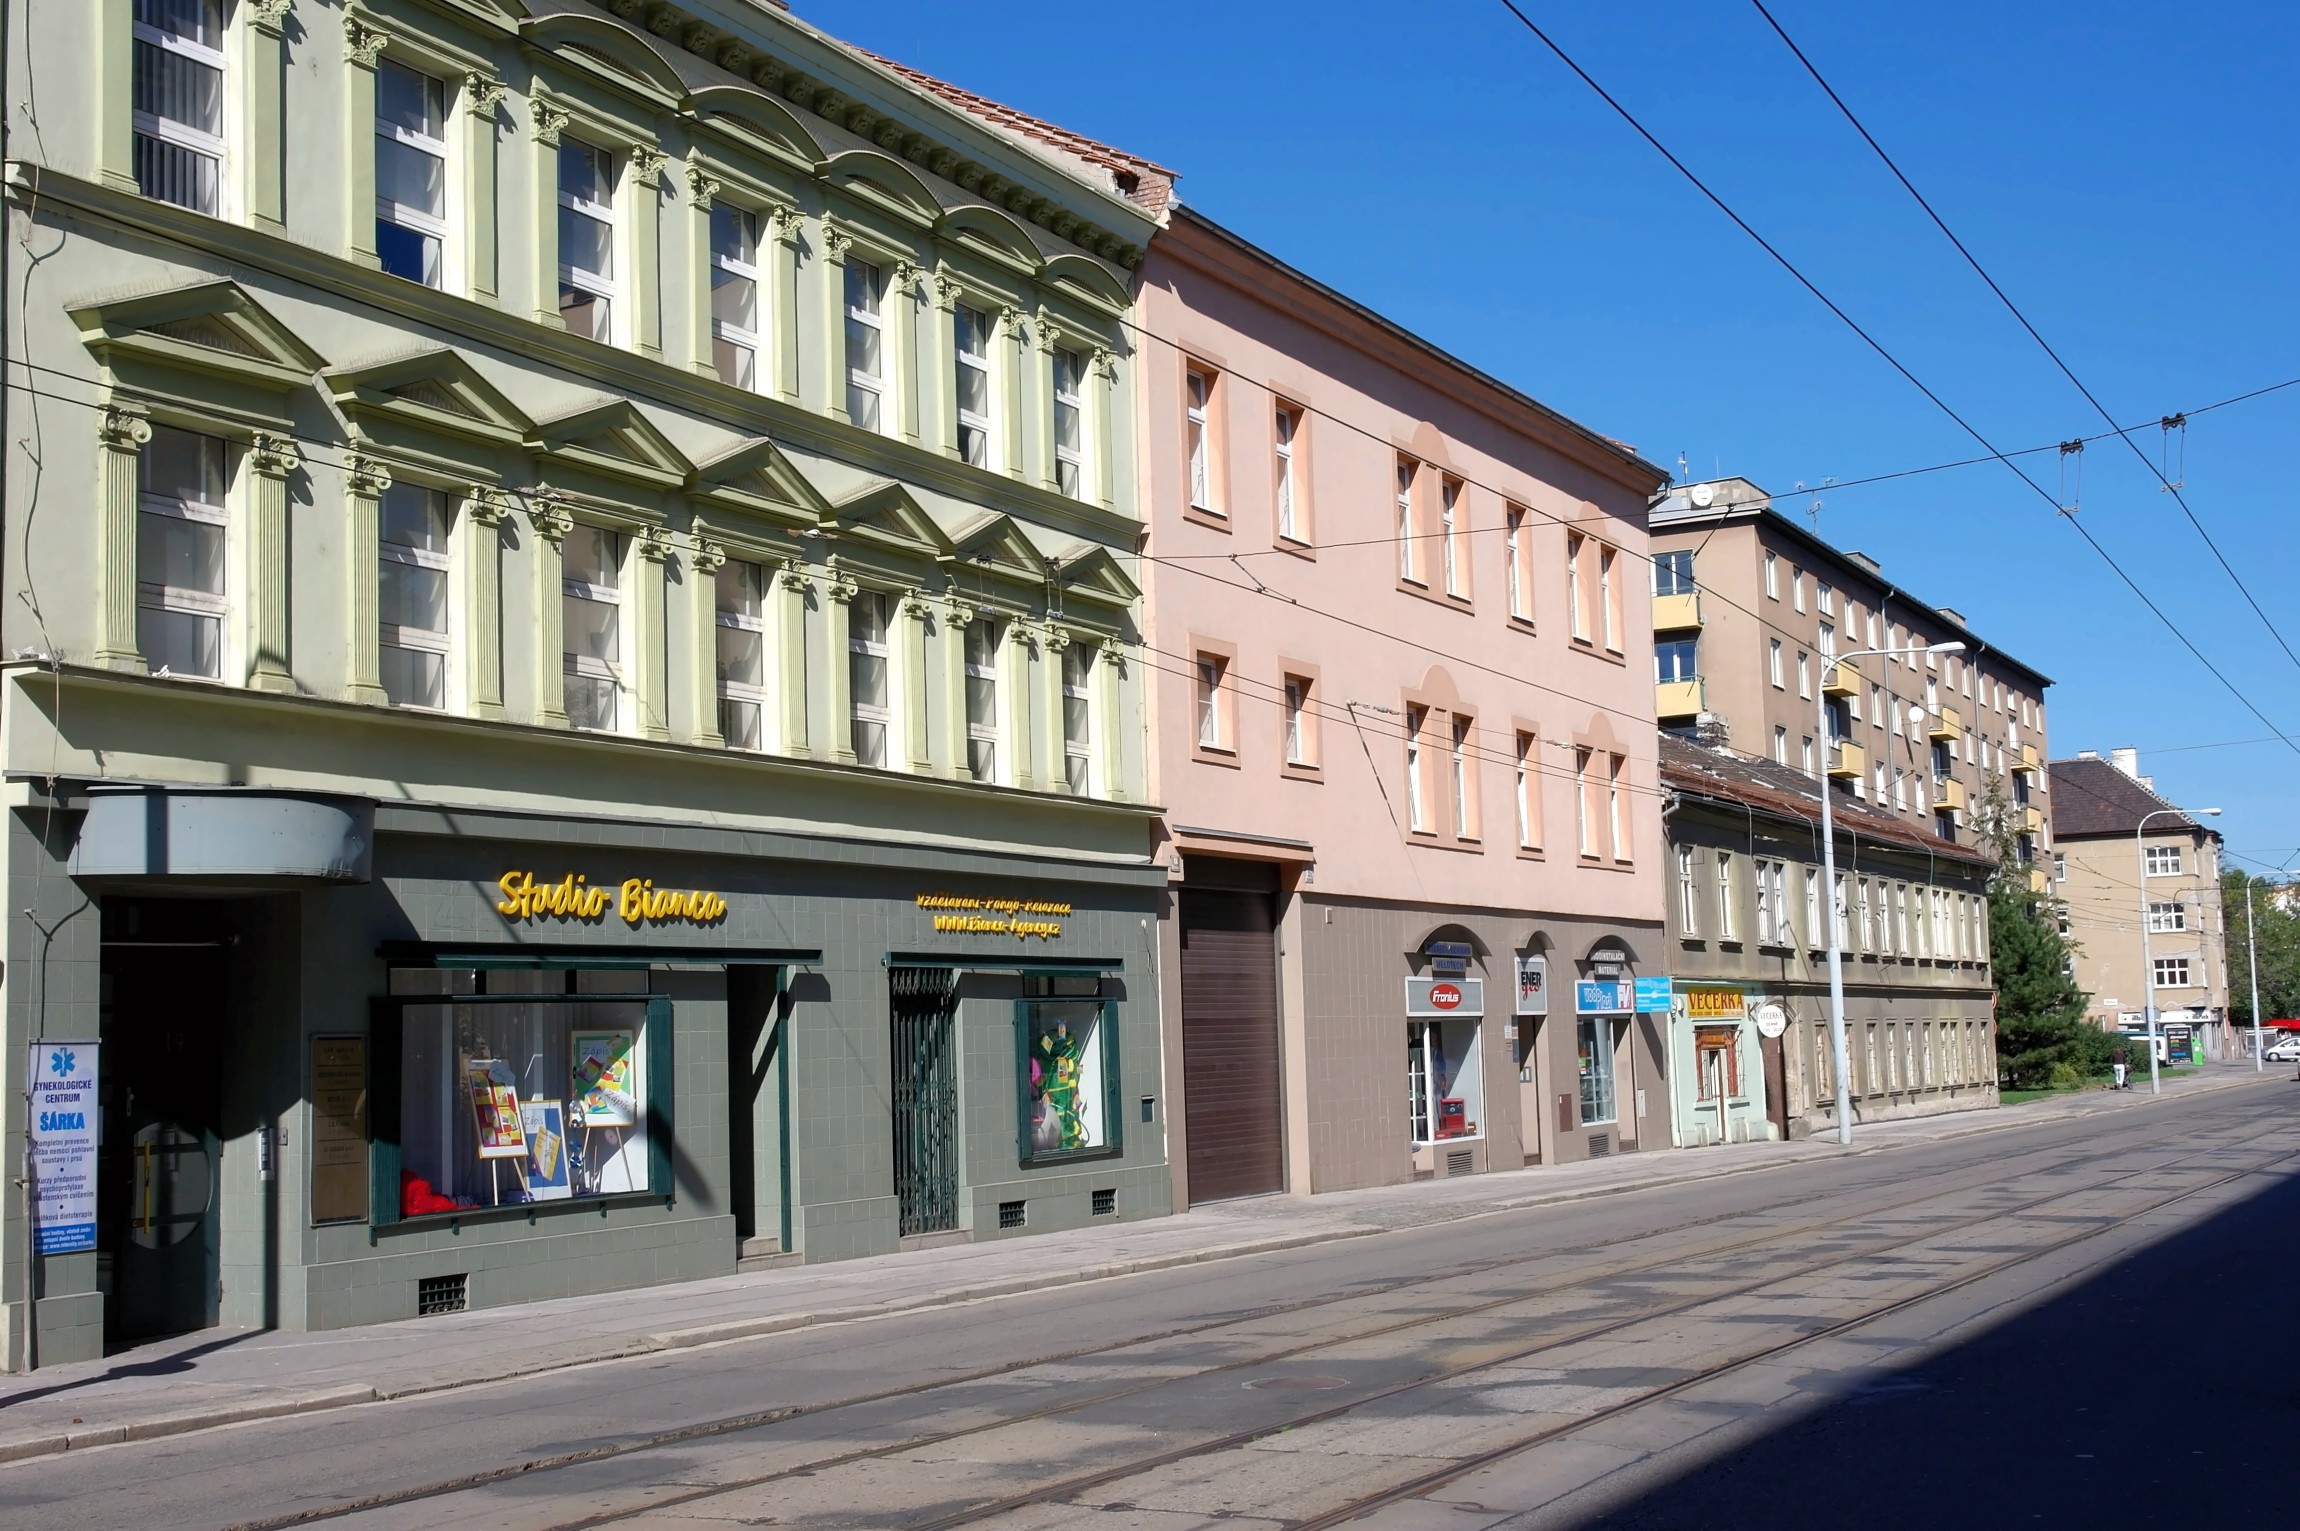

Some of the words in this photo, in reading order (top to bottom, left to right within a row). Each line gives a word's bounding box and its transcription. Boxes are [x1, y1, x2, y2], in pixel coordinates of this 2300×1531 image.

[498, 871, 611, 918] Studio
[619, 878, 726, 922] Bianca
[1521, 971, 1541, 986] ENER
[1433, 990, 1459, 1003] Fronius
[1688, 989, 1744, 1010] VEČERKA
[34, 1079, 92, 1091] GYNEKOLOGICKÉ
[45, 1093, 80, 1103] CENTRUM
[40, 1111, 85, 1131] ŠÁRKA
[525, 1114, 544, 1127] Zápis
[64, 1138, 89, 1146] prevence
